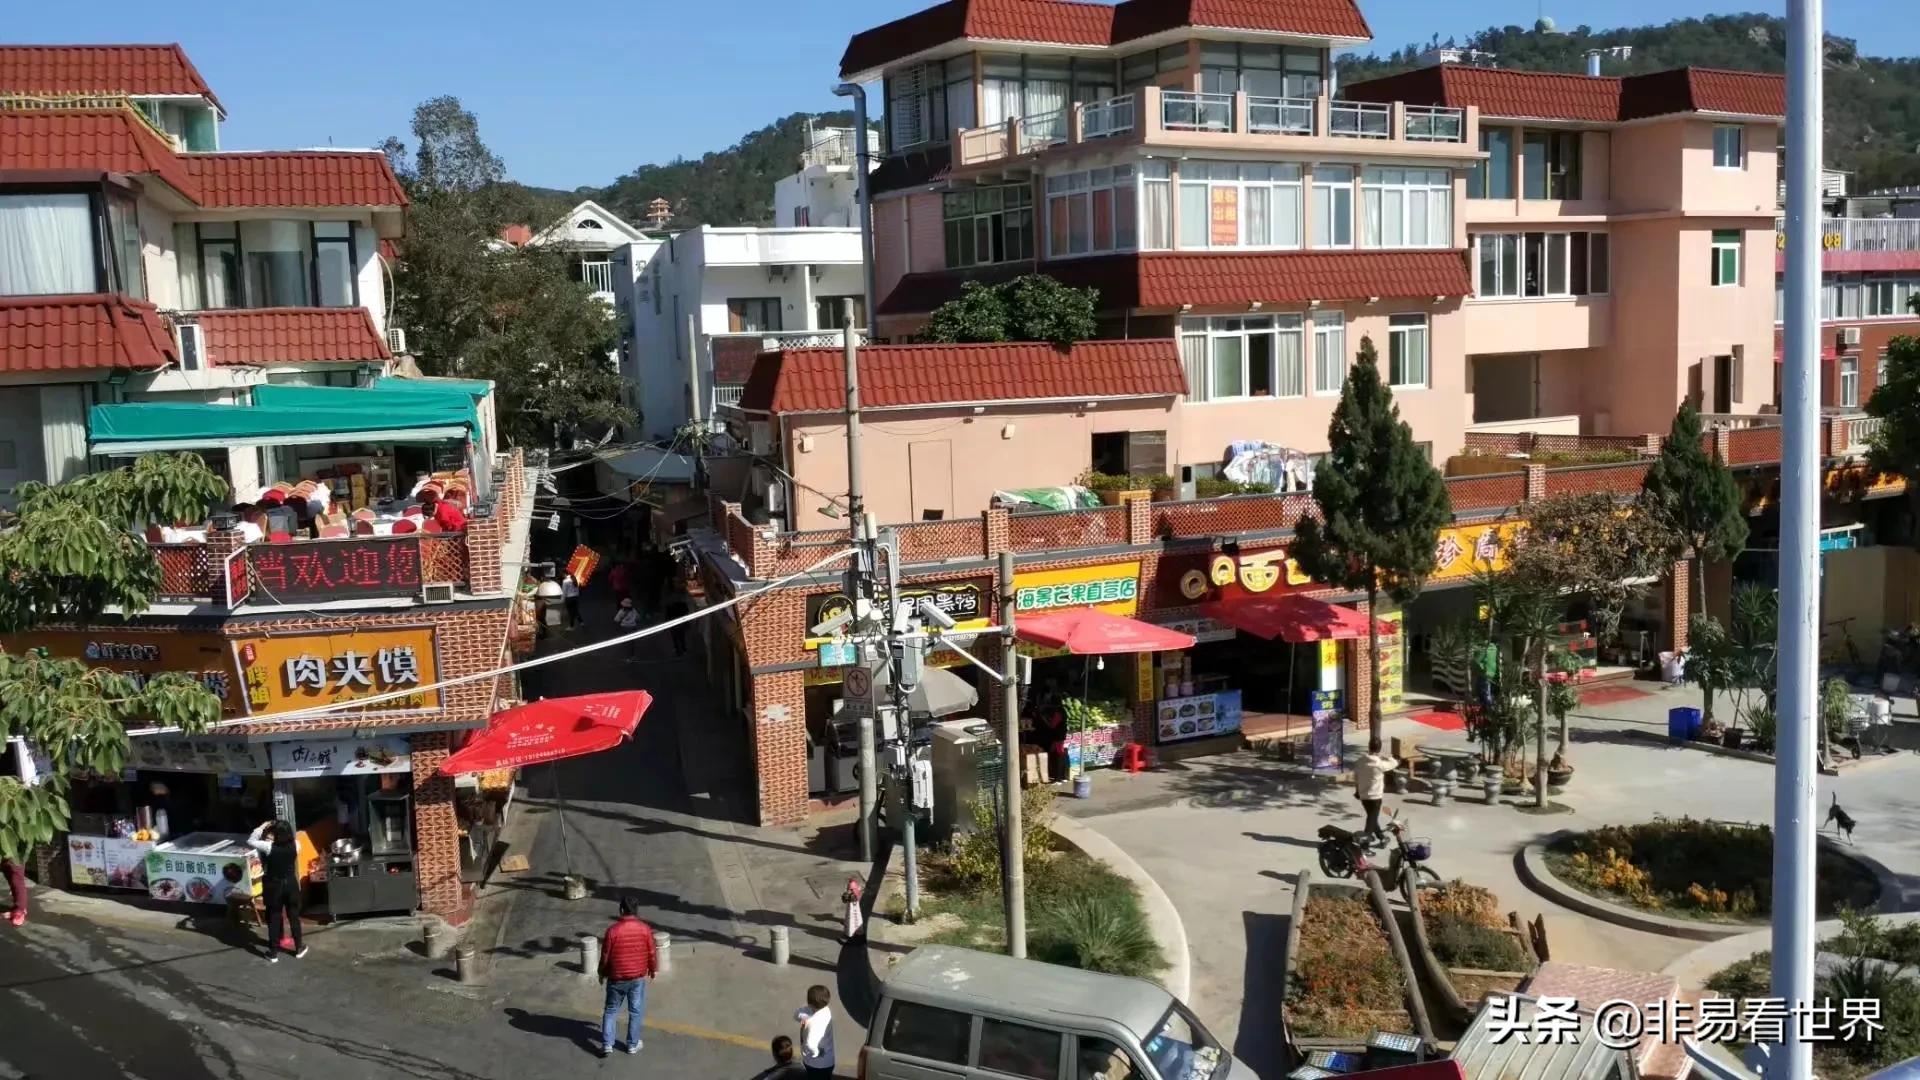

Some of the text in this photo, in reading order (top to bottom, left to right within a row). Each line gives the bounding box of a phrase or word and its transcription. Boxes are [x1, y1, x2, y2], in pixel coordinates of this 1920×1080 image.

[256, 543, 419, 592] 当欢迎您
[1016, 577, 1138, 610] 海景芒果直营店
[286, 645, 419, 690] 肉夹馍
